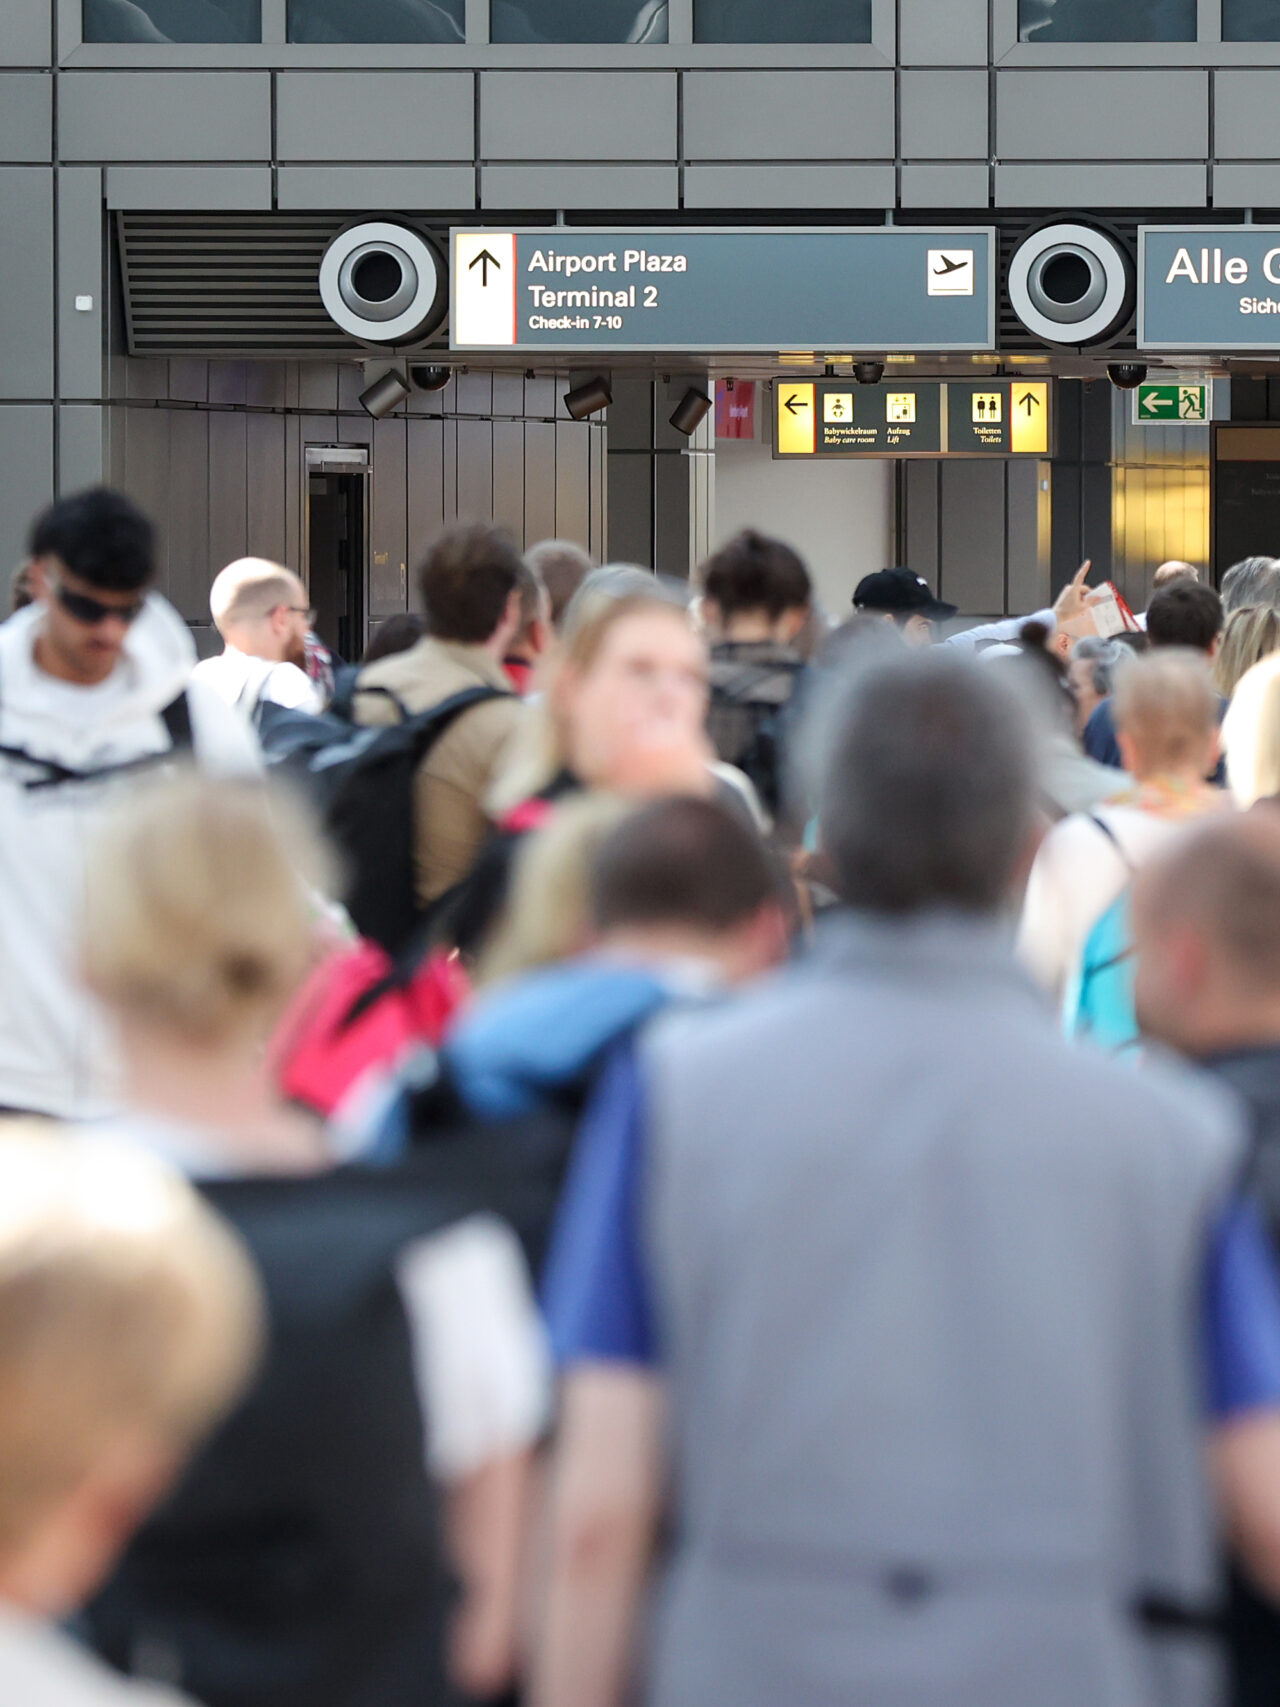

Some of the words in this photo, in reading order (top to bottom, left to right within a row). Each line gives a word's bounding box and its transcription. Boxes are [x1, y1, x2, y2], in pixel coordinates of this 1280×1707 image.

[527, 250, 617, 277] Airport
[623, 250, 687, 272] Plaza
[1165, 248, 1249, 284] Alle
[527, 285, 636, 308] Terminal
[643, 285, 658, 307] 2
[528, 315, 590, 329] Check-in
[592, 315, 623, 329] 7-10
[823, 427, 878, 436] Babywickelraum
[886, 427, 911, 436] Aufzug
[972, 427, 1002, 435] Toiletten
[824, 436, 842, 445] Baby
[886, 436, 900, 445] Lift
[980, 435, 1002, 444] Toilets
